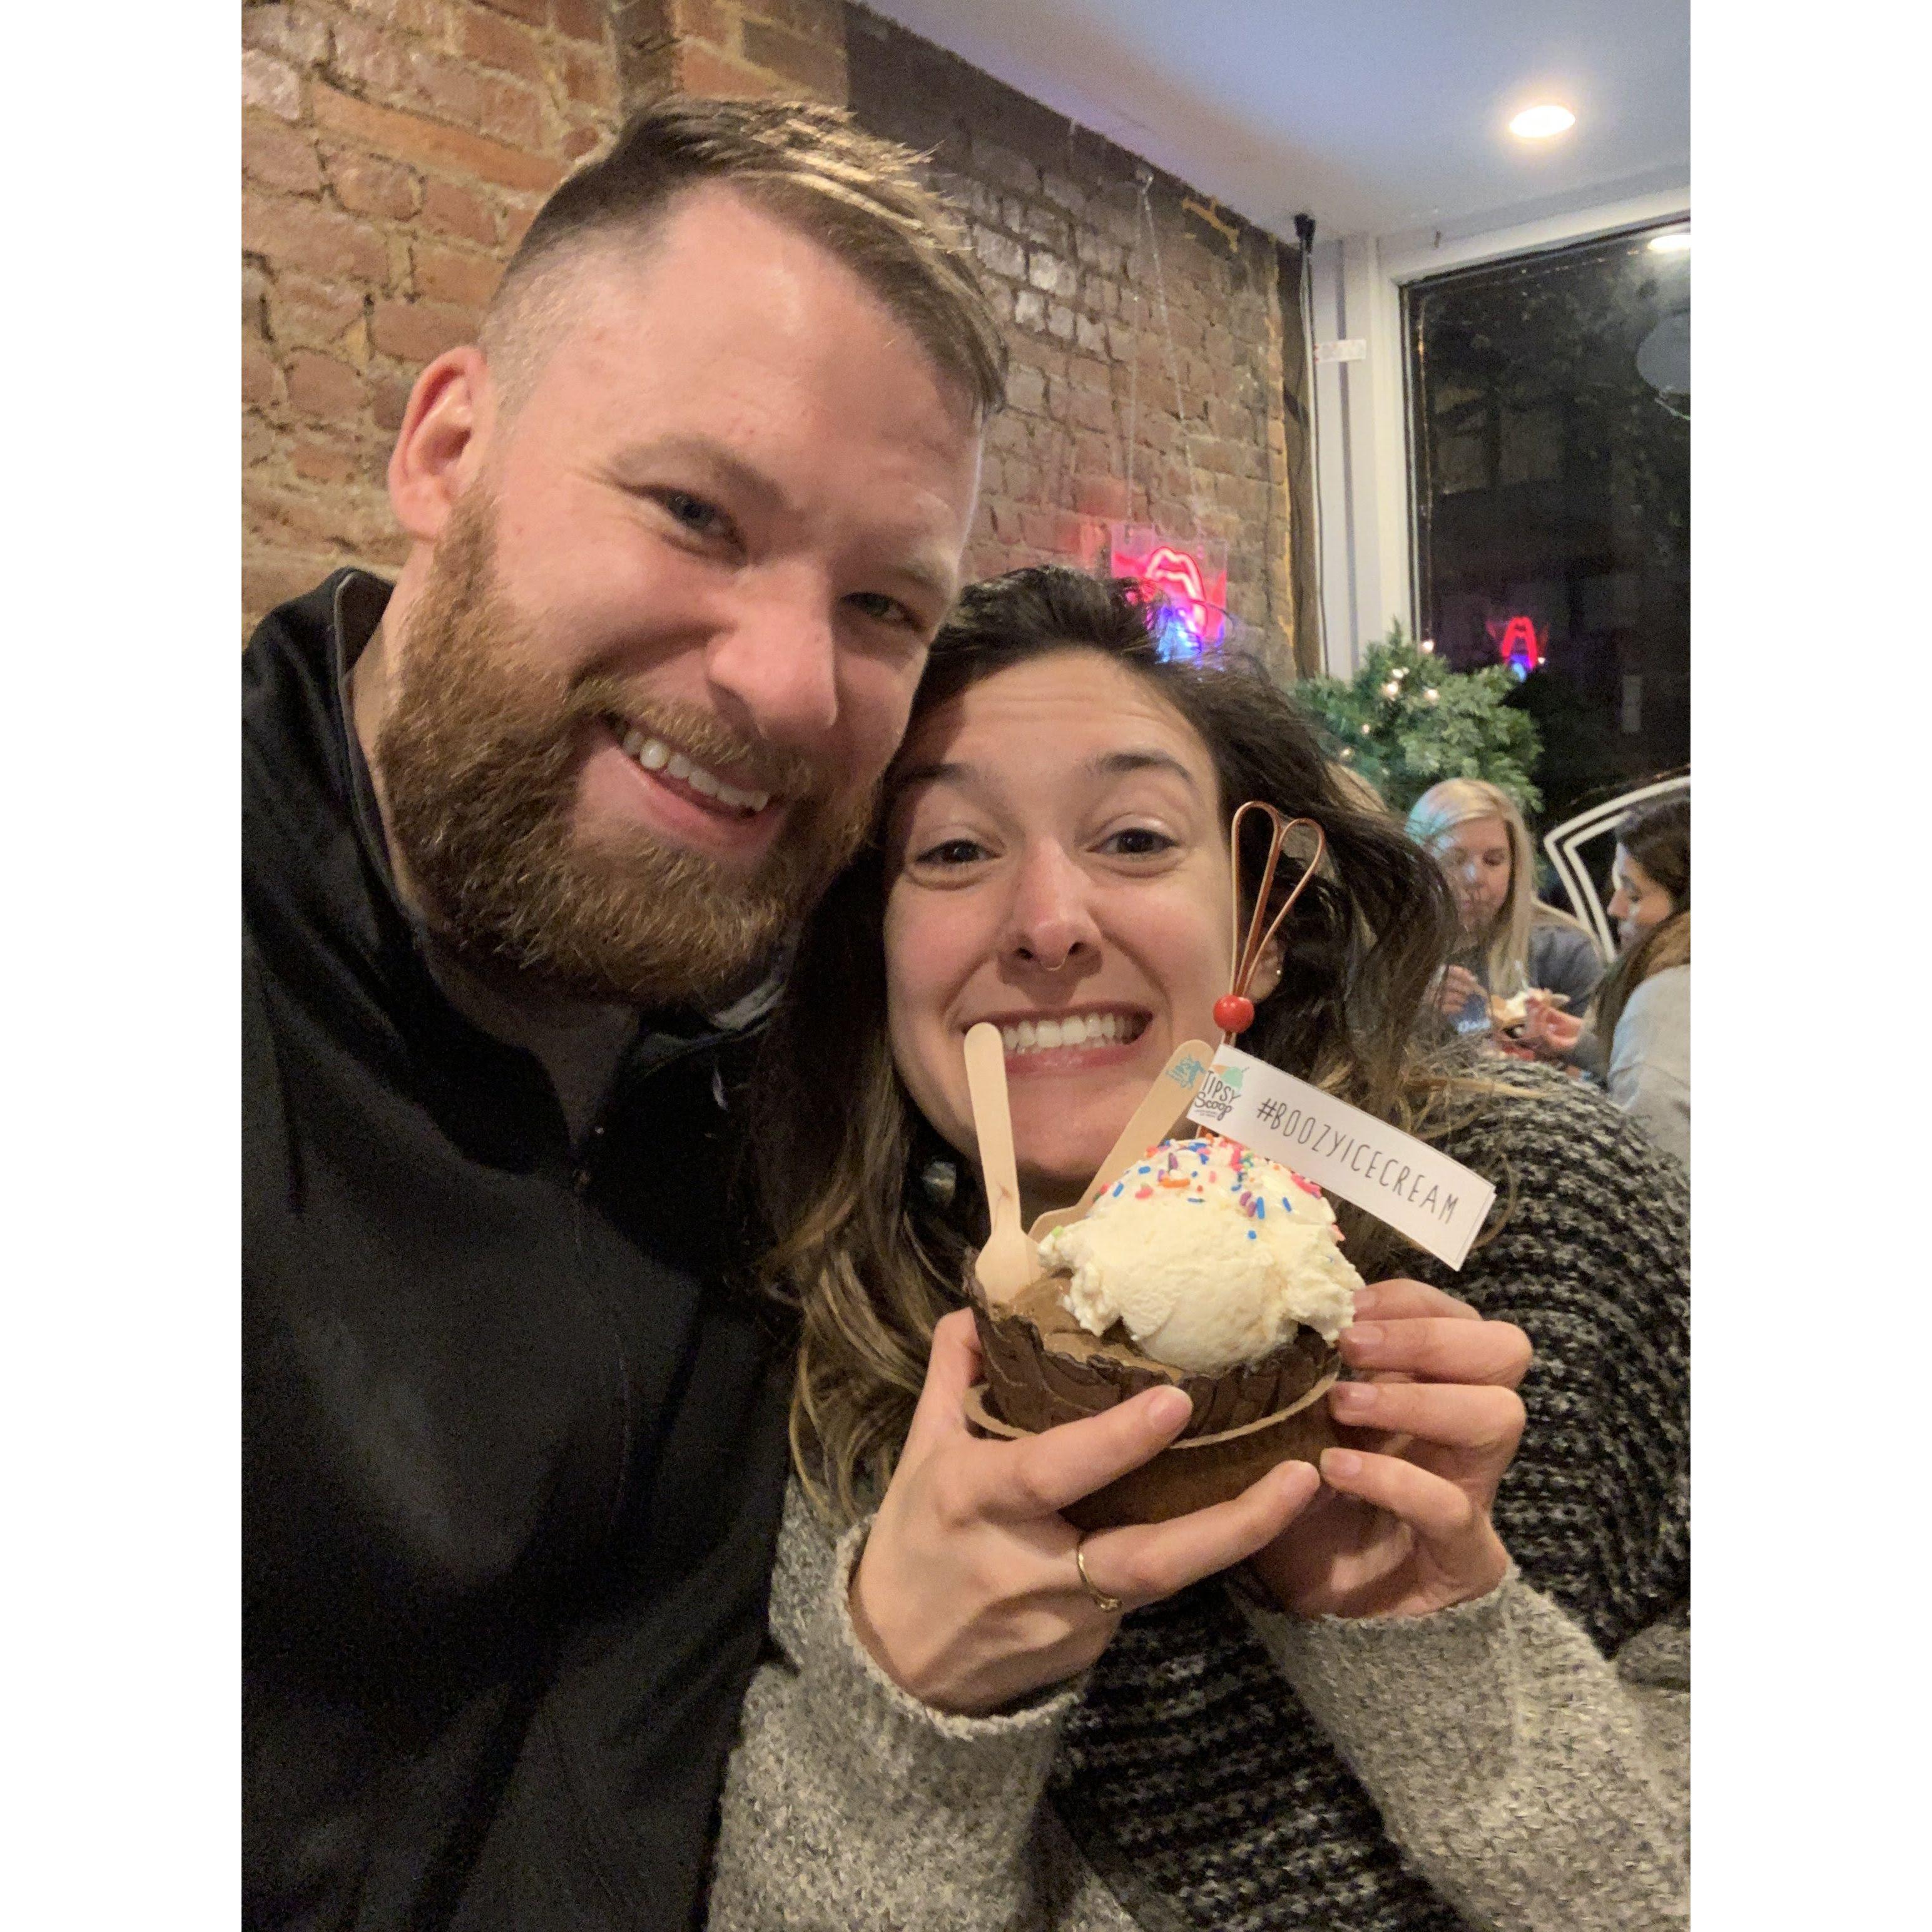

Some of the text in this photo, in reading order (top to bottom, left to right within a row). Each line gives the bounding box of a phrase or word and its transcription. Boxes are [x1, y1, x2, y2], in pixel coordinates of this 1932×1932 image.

[1202, 1070, 1241, 1104] TIPSY
[1194, 1092, 1234, 1121] Scoop
[1257, 1098, 1459, 1224] #BOOZYICECREAM
